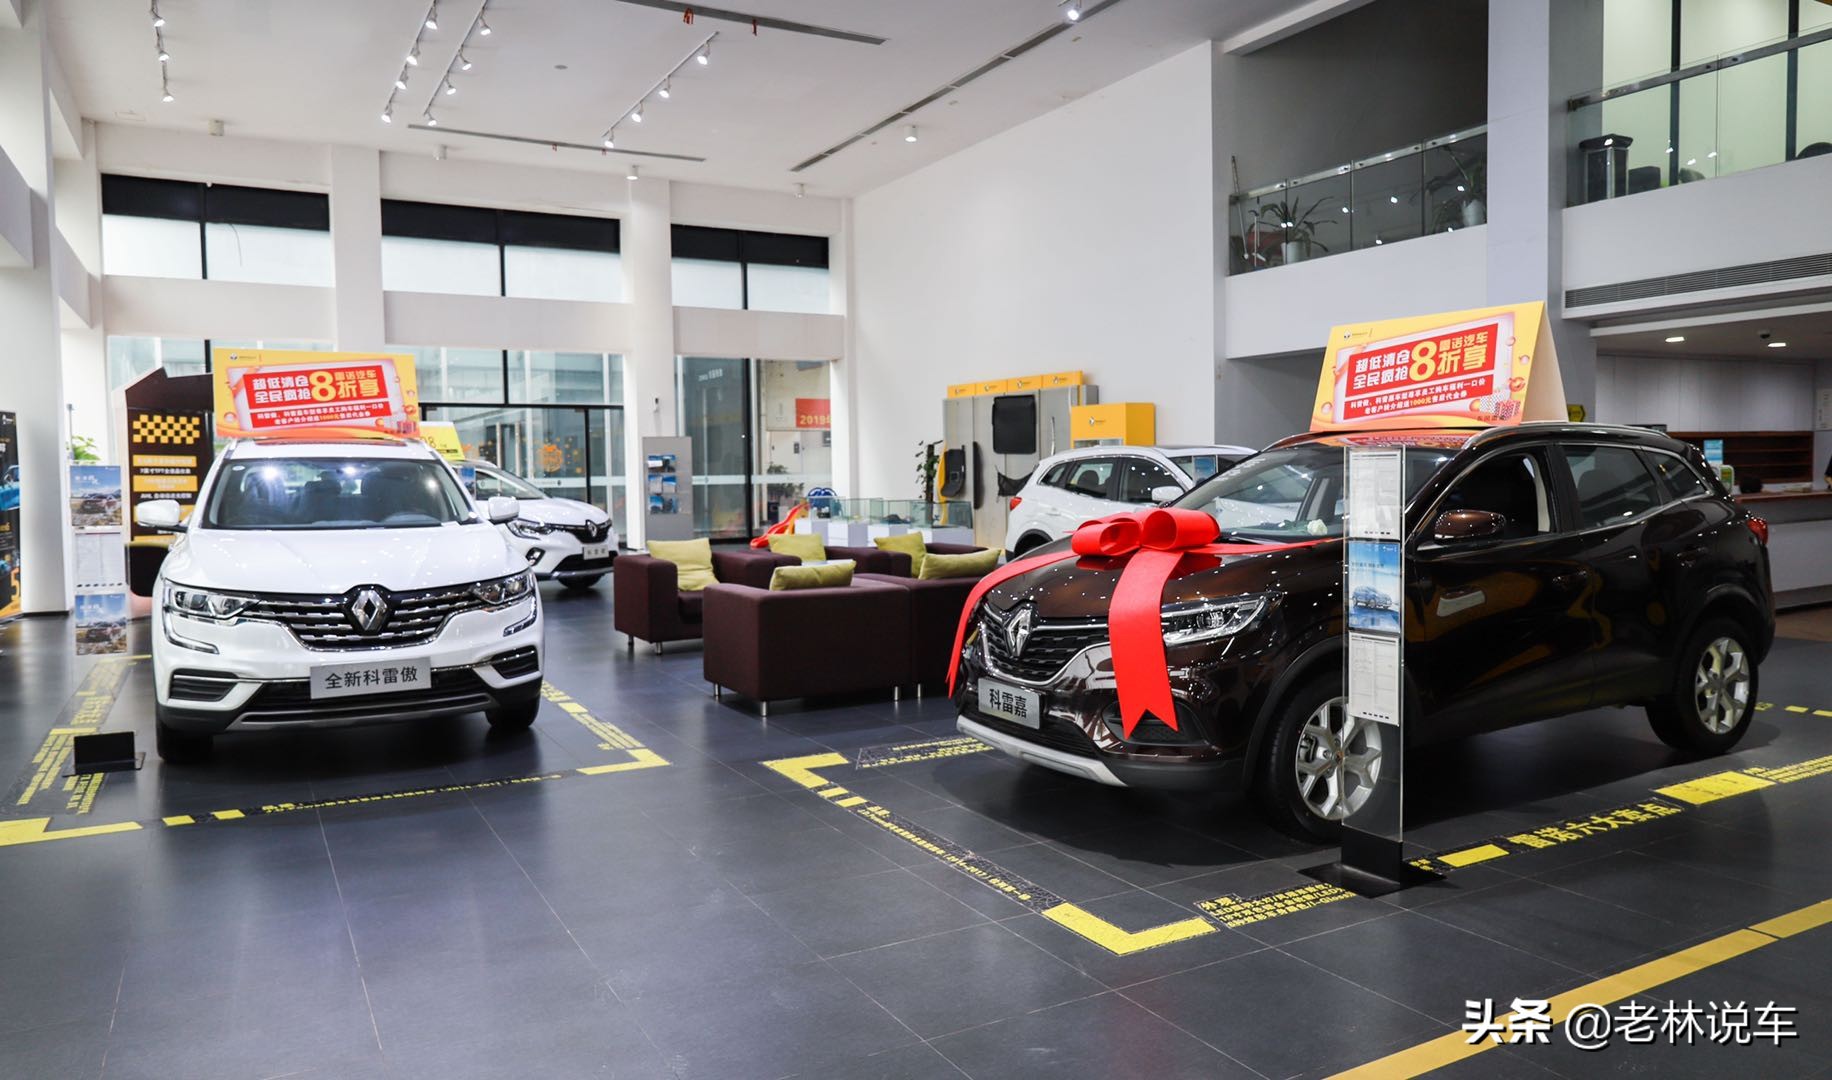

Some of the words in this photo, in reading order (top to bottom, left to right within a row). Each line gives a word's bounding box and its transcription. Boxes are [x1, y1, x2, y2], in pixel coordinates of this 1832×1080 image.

[1355, 350, 1411, 374] 超低清仓
[1438, 331, 1489, 351] 雷诺汽车
[252, 375, 309, 391] 超低清仓
[1352, 366, 1409, 390] 全民疯抢
[254, 389, 312, 404] 全民疯抢
[325, 665, 418, 690] 全新科雷傲
[989, 688, 1028, 718] 科雷嘉
